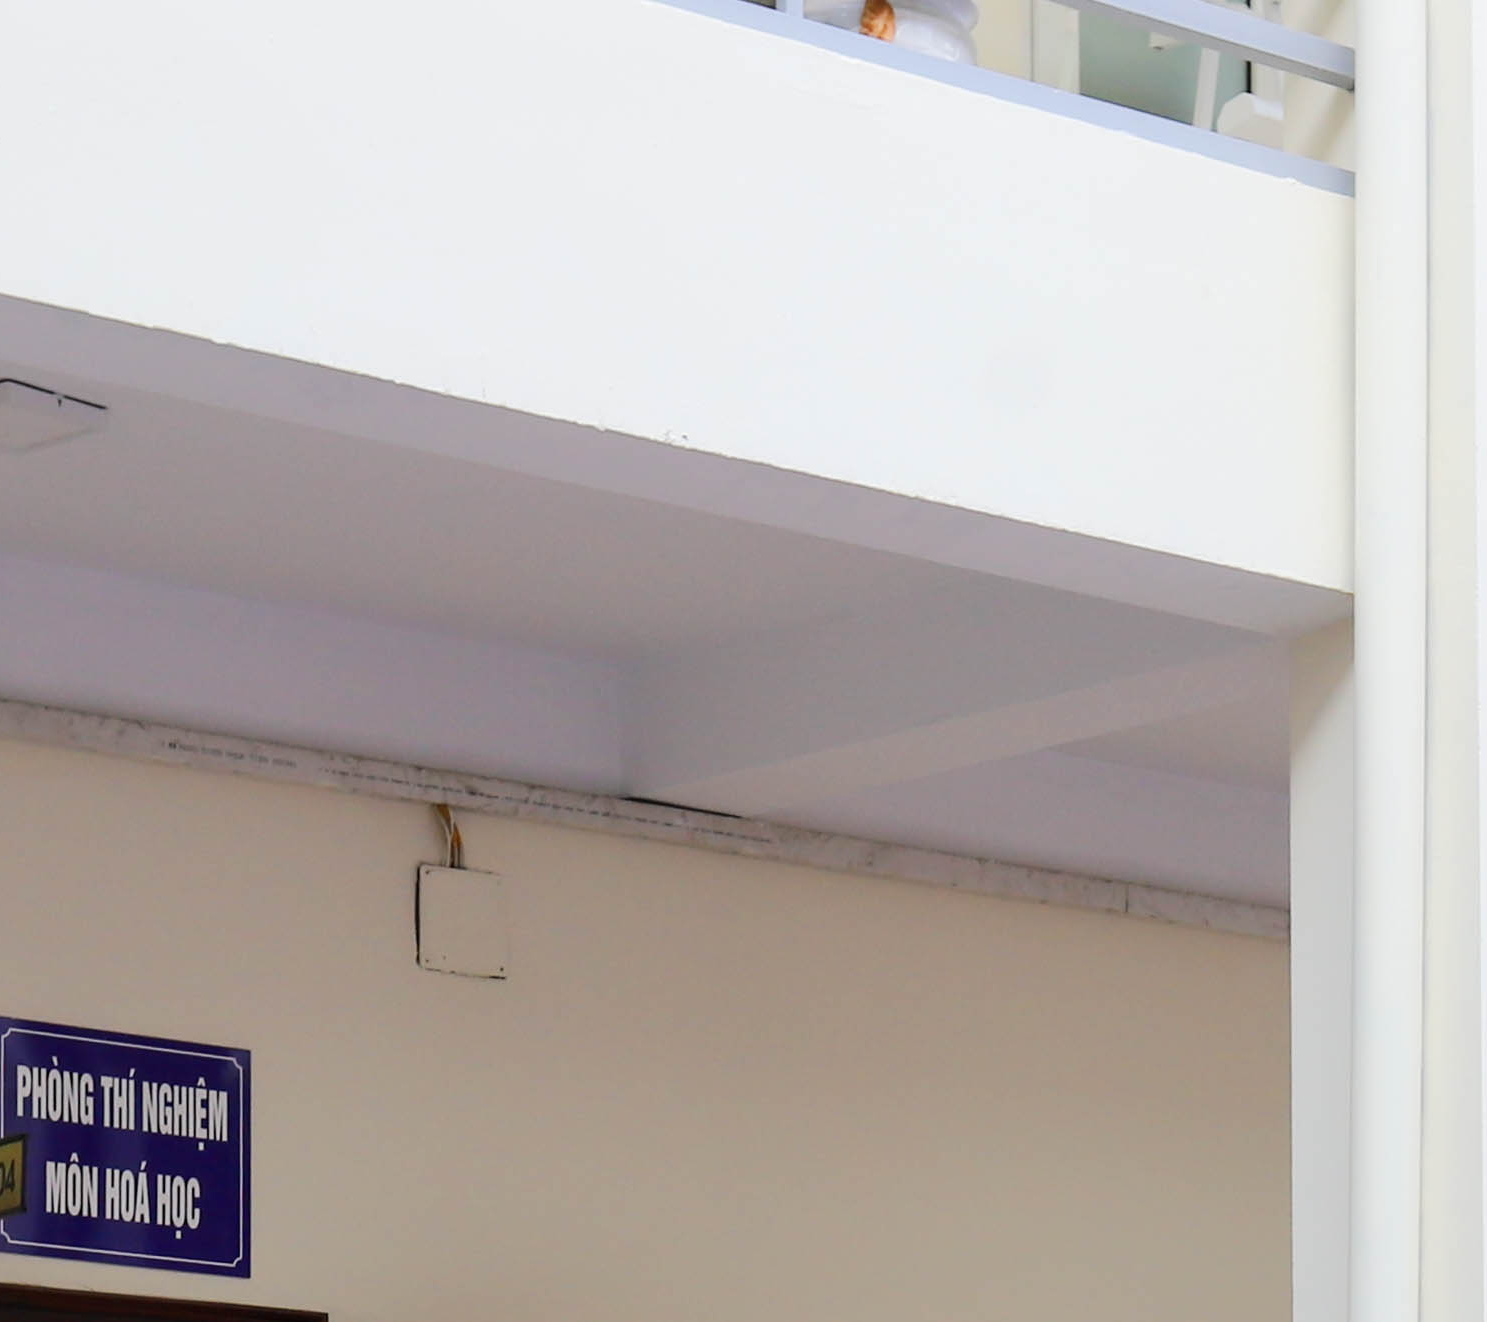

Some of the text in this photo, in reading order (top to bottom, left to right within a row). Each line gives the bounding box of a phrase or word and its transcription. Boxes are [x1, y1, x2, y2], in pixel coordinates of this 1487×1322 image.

[16, 1056, 228, 1151] PHÒNG THÍ NGHIỆM
[45, 1152, 201, 1239] MÔN HOÁ HỌC
